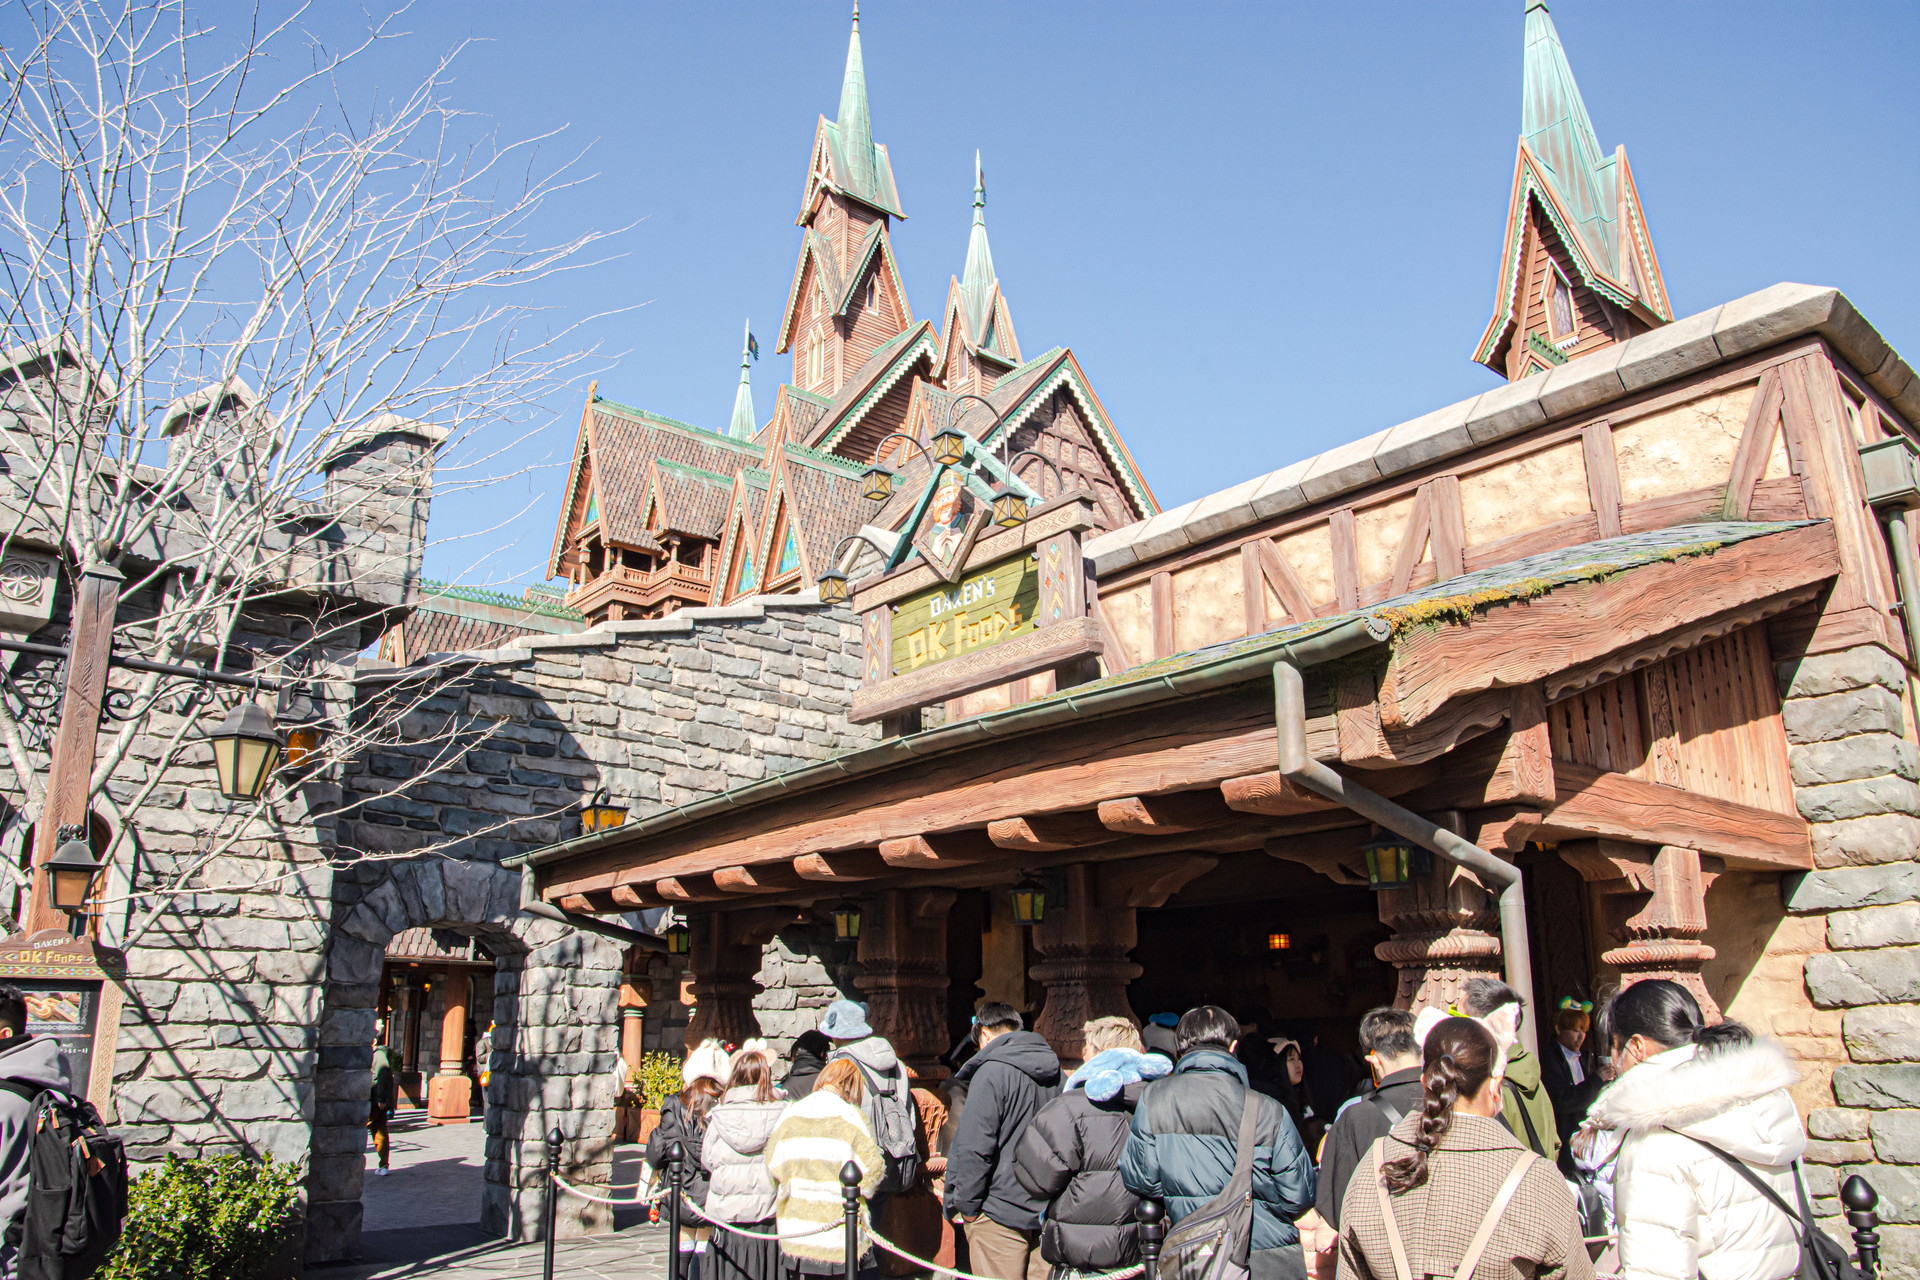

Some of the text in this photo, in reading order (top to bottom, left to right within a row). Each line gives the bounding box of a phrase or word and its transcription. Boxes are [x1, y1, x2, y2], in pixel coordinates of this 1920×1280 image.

[930, 575, 996, 618] OAKEN'S
[908, 620, 948, 669] OK
[19, 950, 42, 963] OK
[33, 936, 71, 949] OAKEN'S
